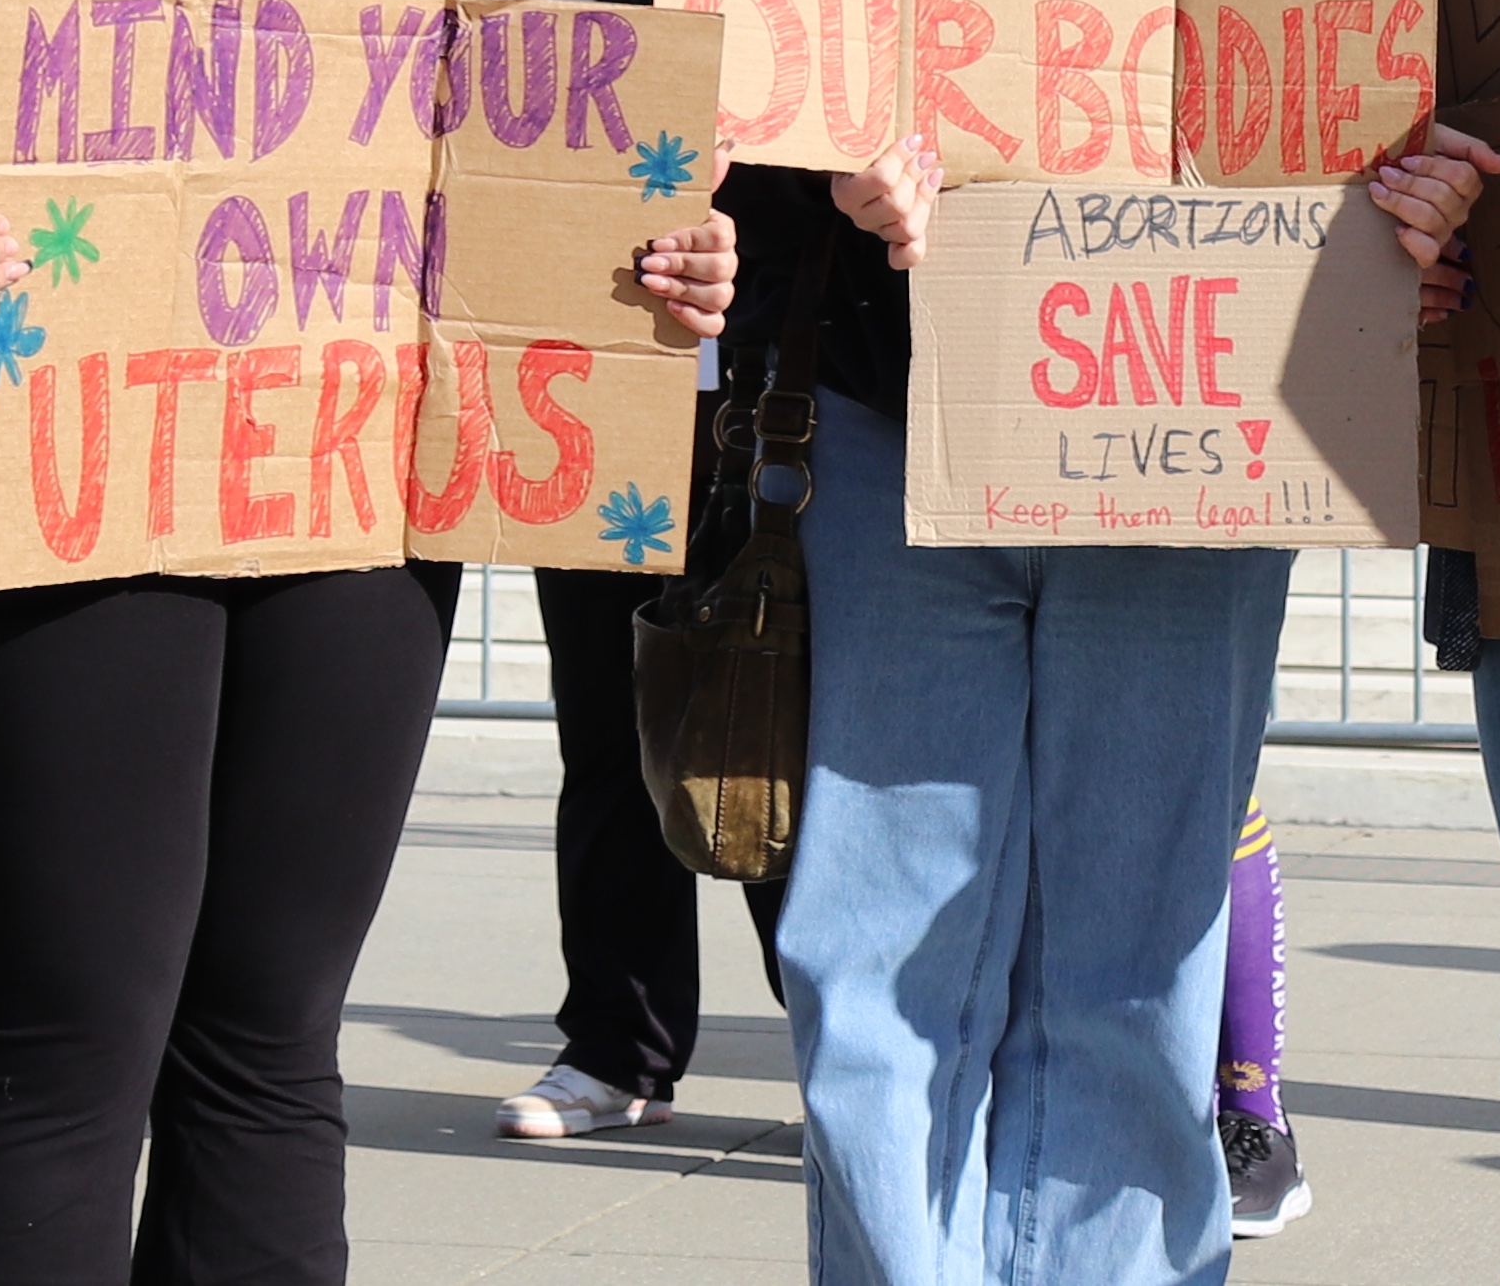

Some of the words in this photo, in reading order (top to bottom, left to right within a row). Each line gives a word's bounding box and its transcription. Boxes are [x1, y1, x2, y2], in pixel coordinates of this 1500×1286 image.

[348, 4, 638, 154] YOUR
[195, 189, 447, 347] OWN
[1022, 187, 1328, 266] ABORTIONS
[1030, 274, 1242, 409] SAVE
[29, 338, 594, 564] UTERUS
[985, 484, 1070, 535] Keep
[1094, 490, 1172, 529] them
